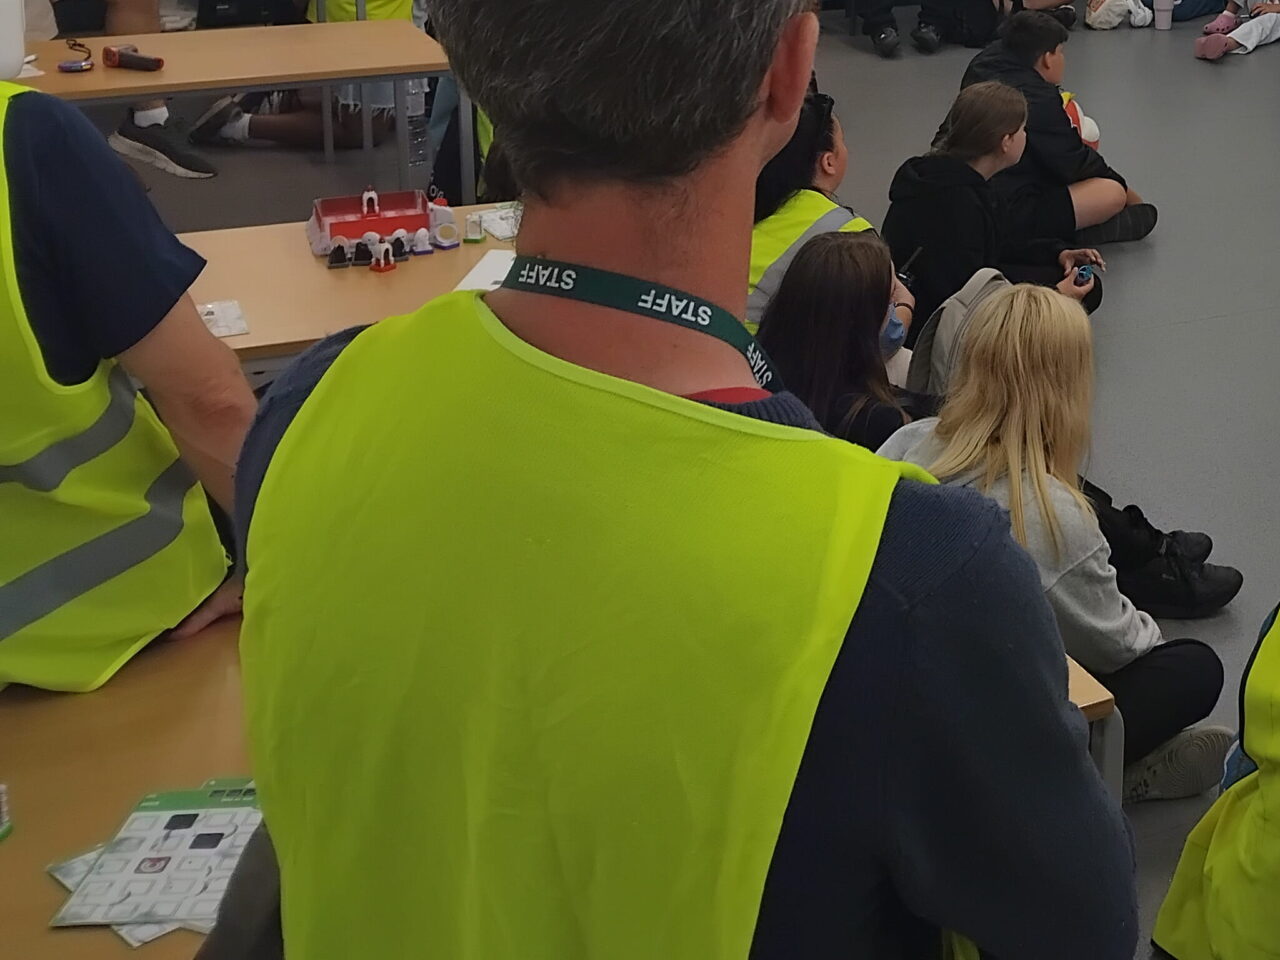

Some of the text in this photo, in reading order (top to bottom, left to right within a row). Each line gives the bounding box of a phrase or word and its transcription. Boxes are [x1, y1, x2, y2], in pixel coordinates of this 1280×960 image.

[518, 263, 577, 290] STAFF
[637, 289, 713, 326] STAFF
[746, 341, 773, 389] STAFF
